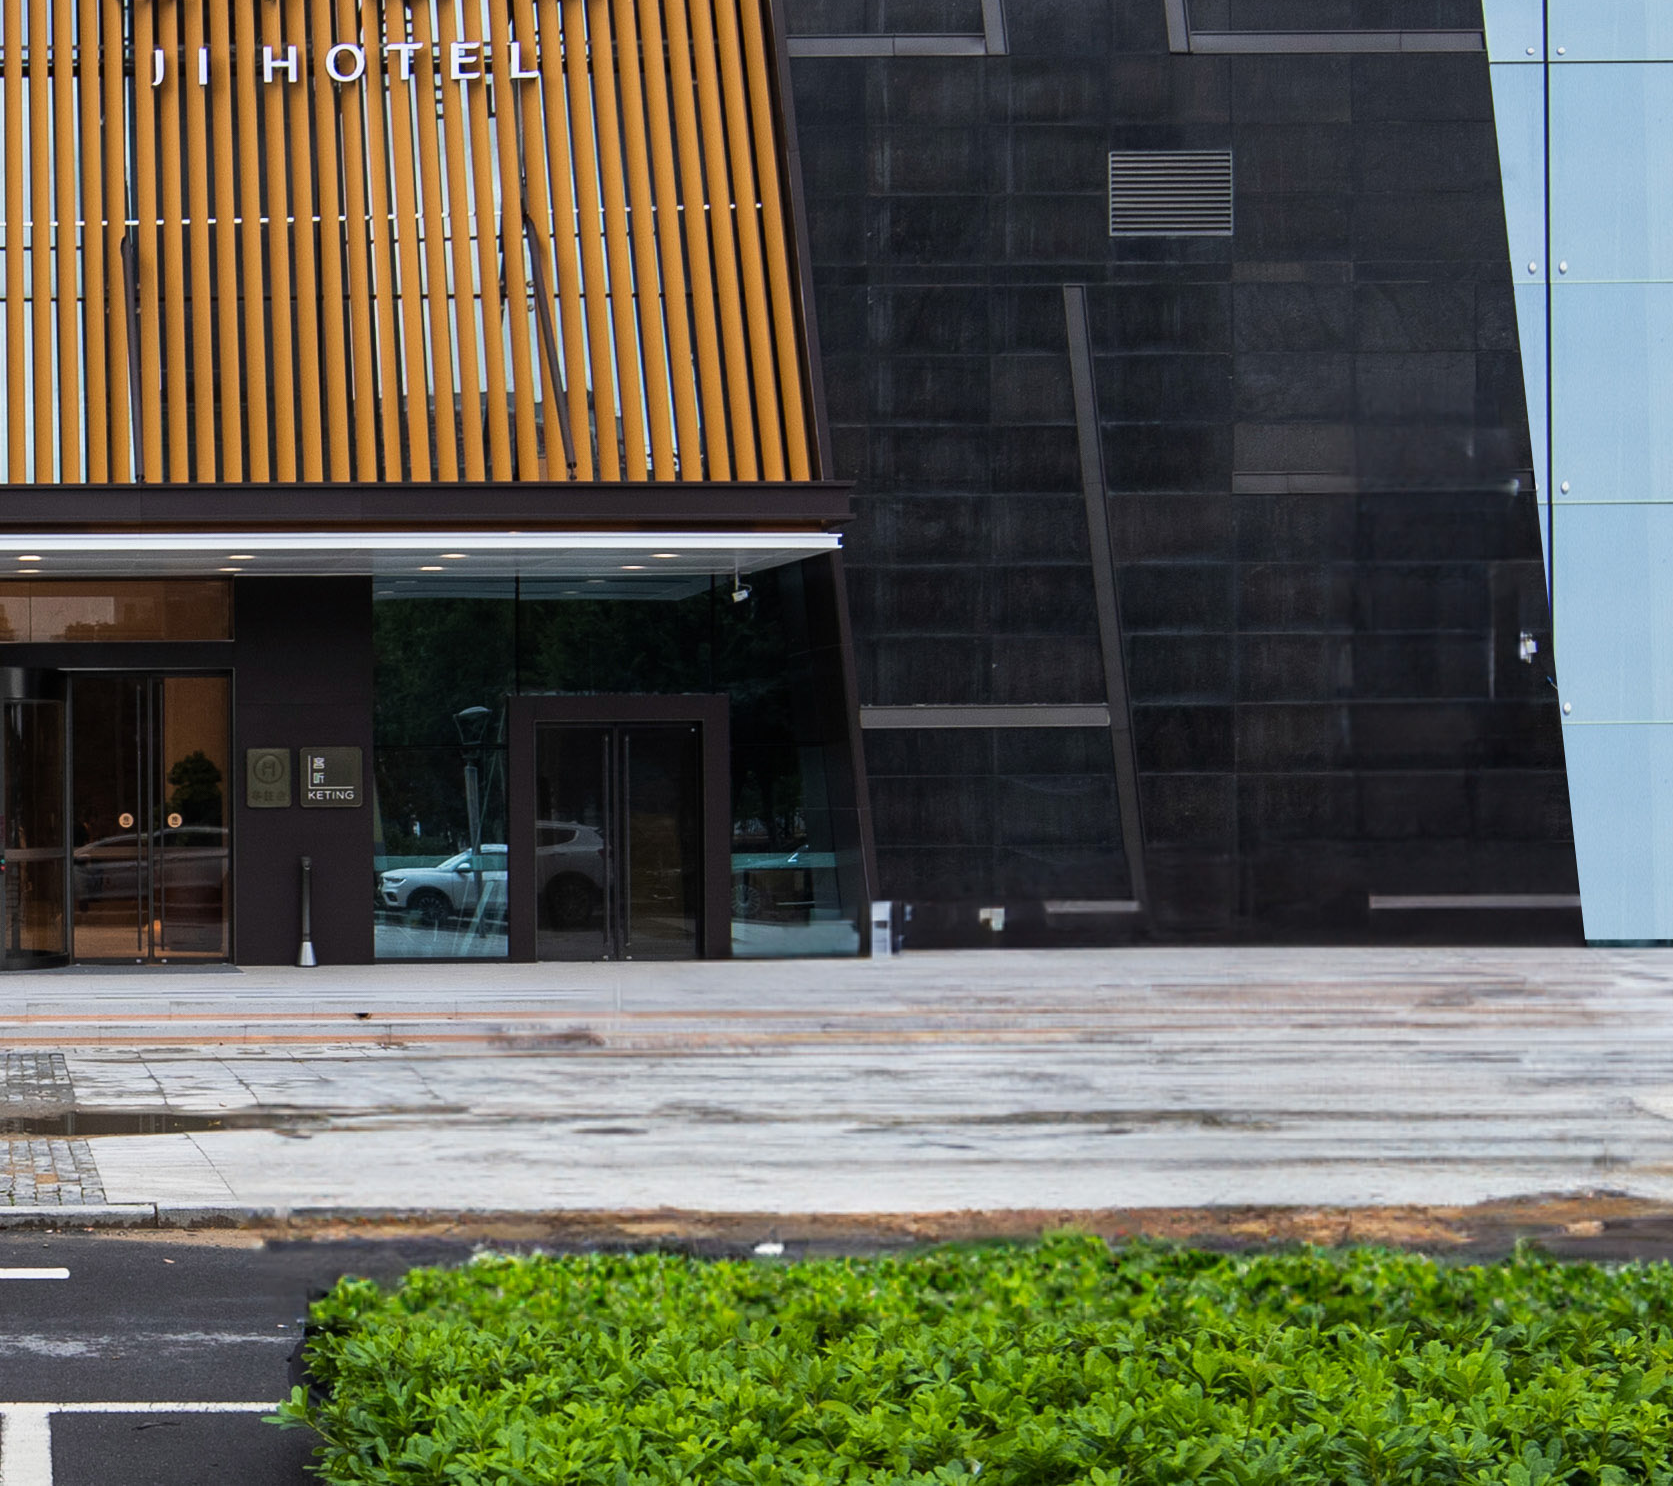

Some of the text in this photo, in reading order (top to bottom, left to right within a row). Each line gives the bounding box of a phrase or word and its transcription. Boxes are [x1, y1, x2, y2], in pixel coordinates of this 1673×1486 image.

[152, 41, 540, 87] JI HOTEL
[307, 790, 355, 800] KETING
